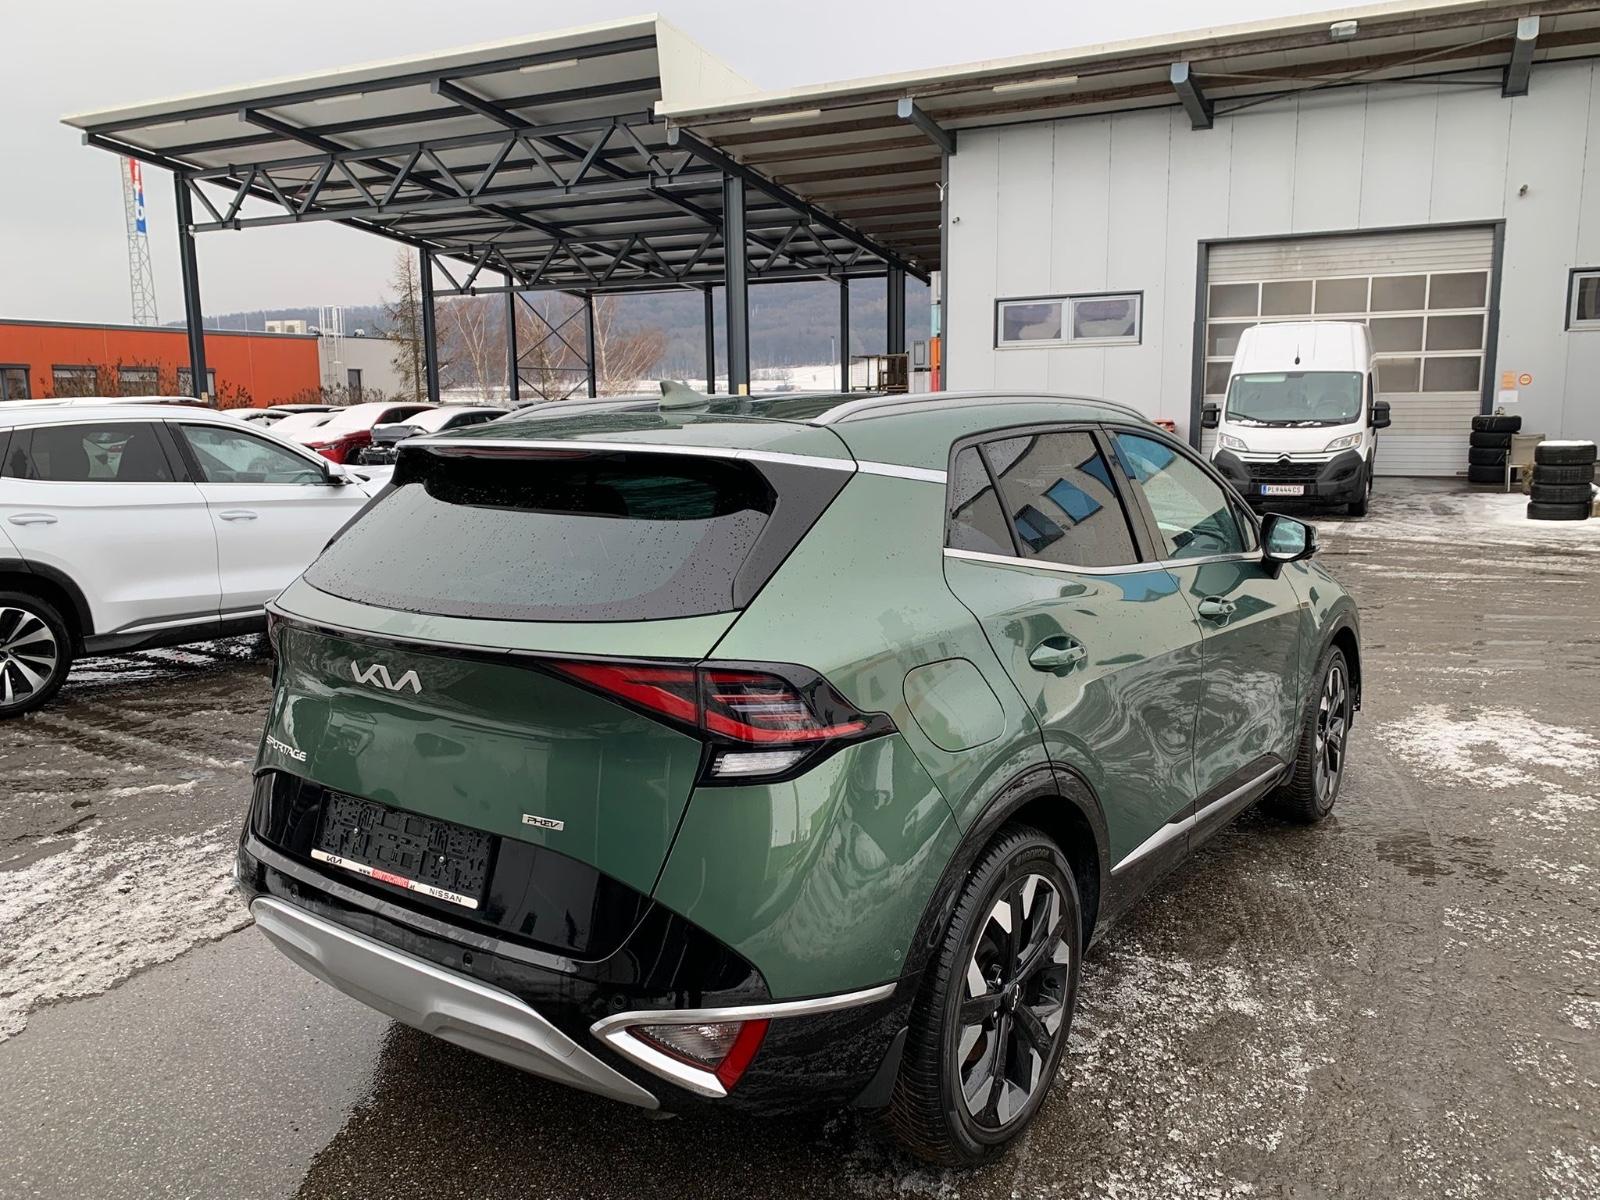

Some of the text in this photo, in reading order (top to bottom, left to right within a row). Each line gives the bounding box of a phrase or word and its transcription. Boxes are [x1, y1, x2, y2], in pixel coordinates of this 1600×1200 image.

[350, 660, 422, 694] KIA
[527, 816, 560, 828] PHEV
[429, 887, 462, 903] NISSAN
